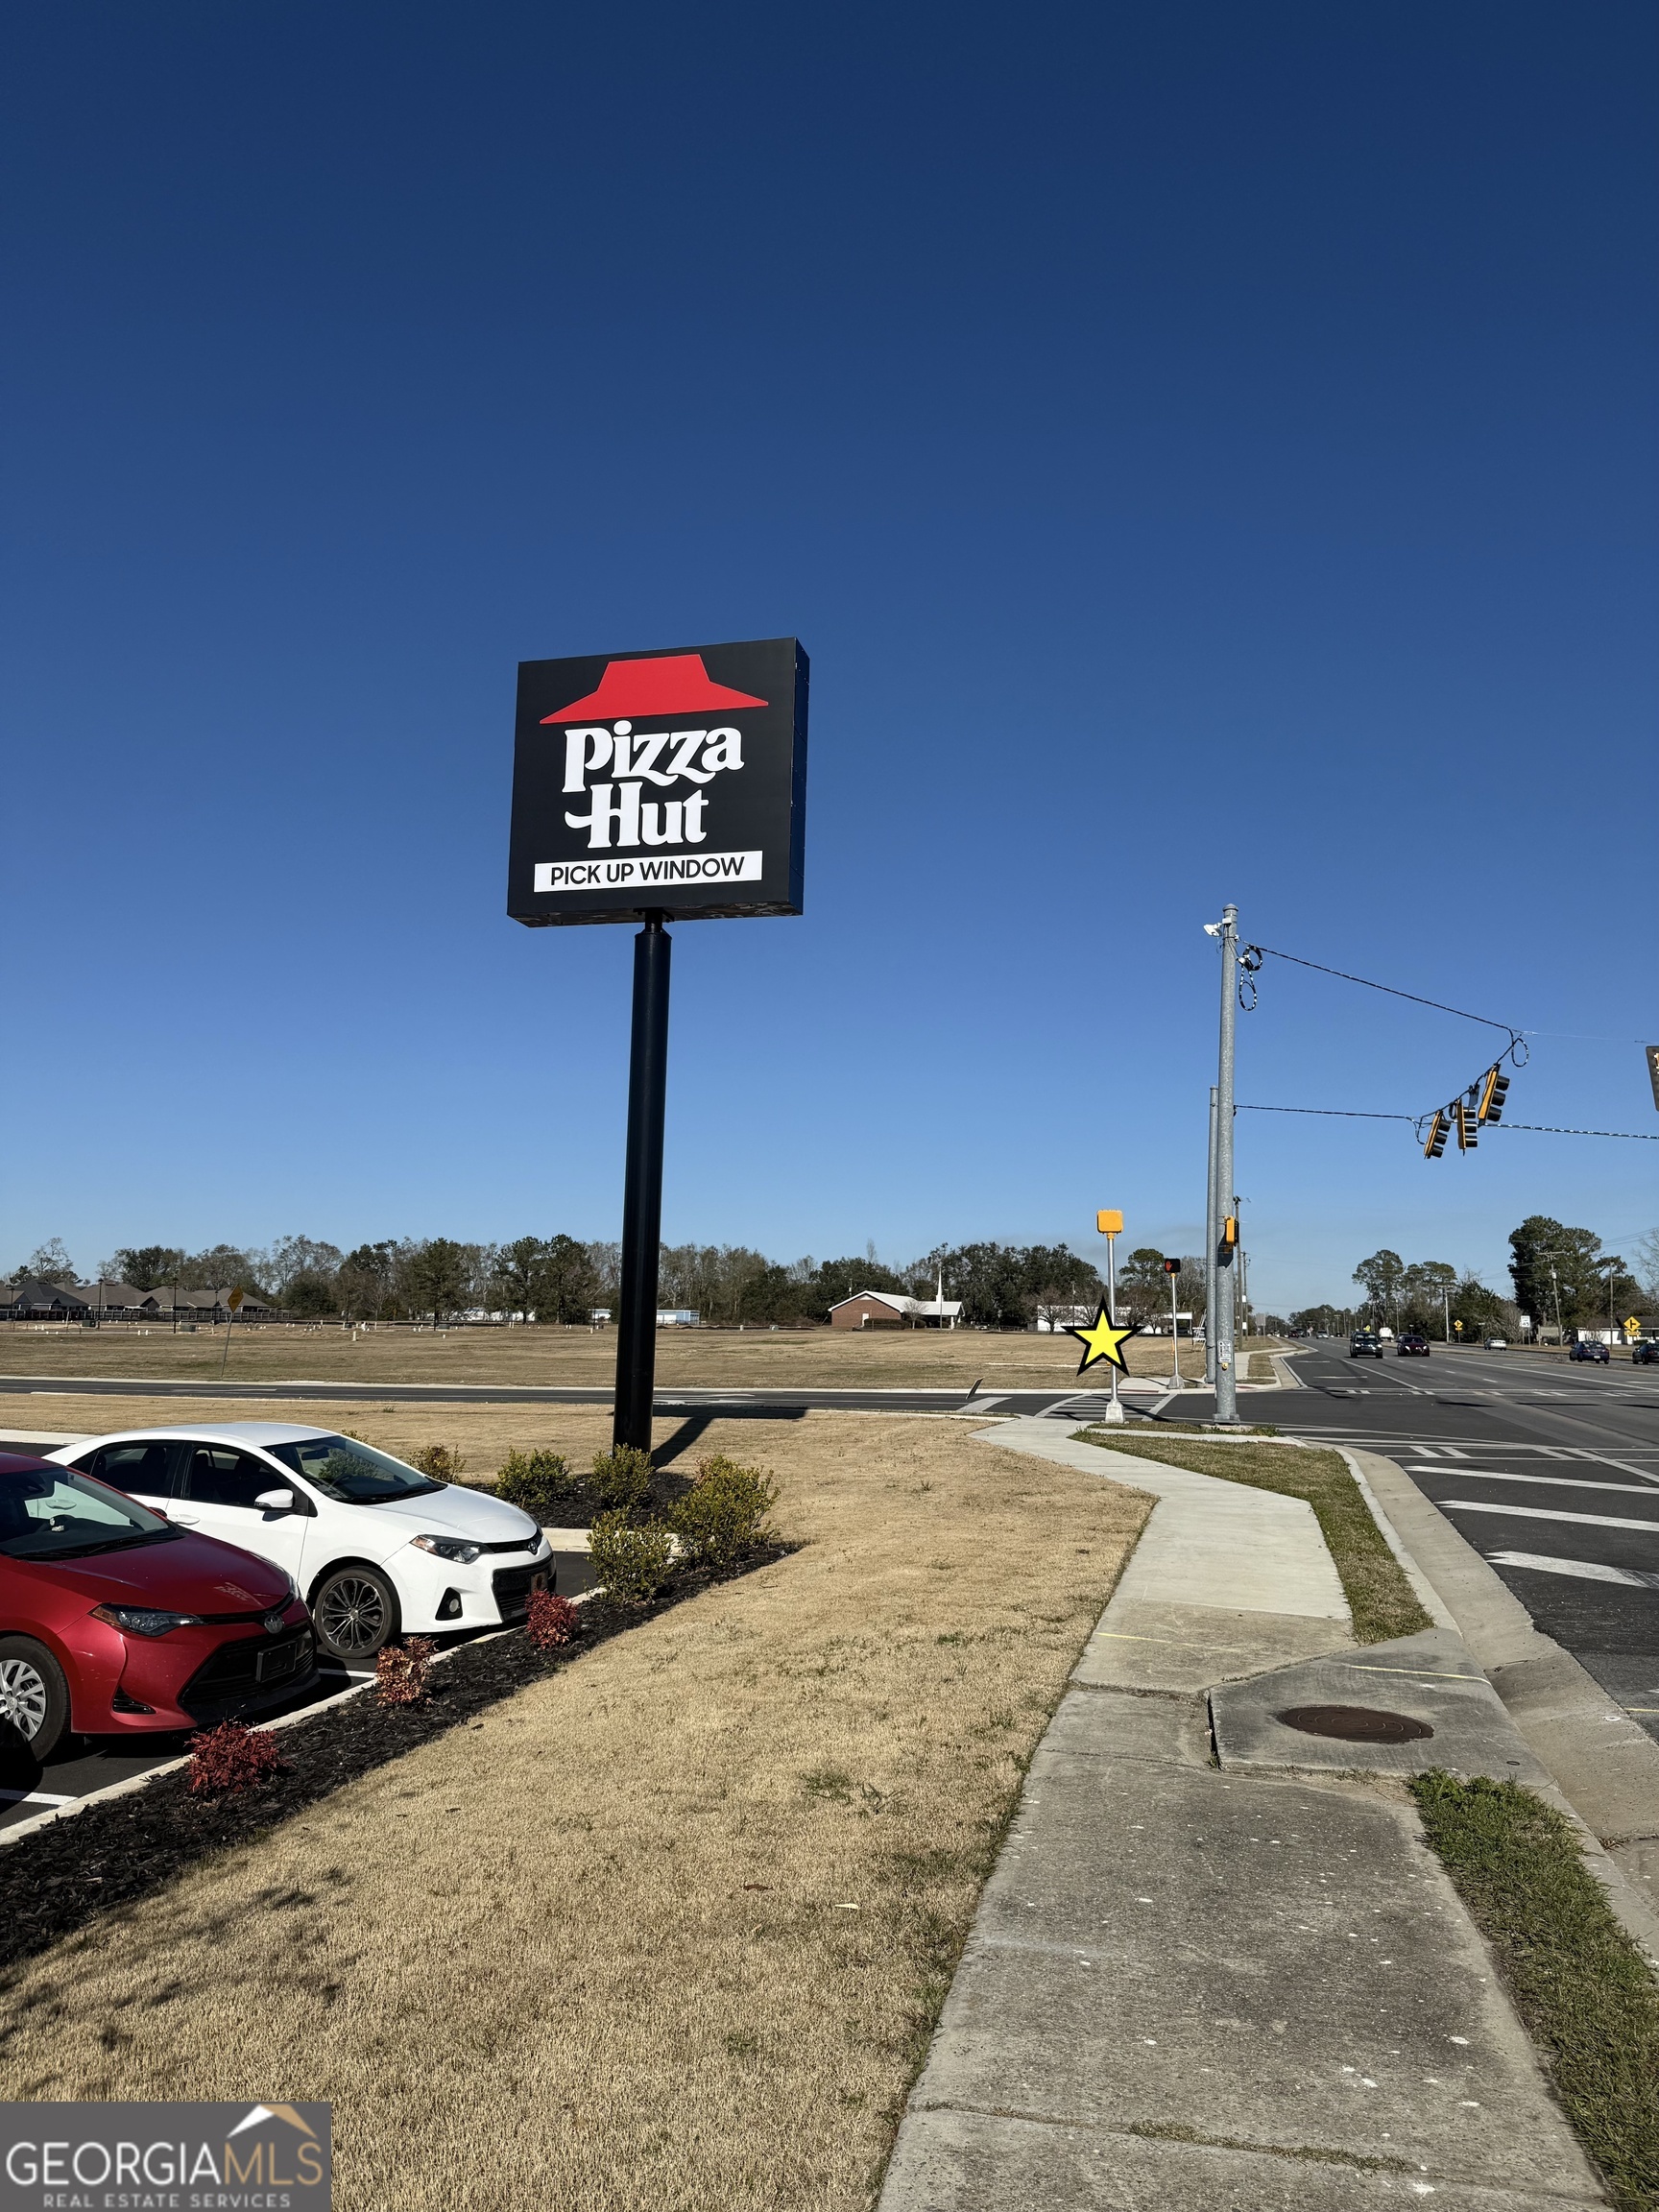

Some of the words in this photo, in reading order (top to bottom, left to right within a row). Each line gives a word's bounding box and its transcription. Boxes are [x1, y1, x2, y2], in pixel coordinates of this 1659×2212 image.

[562, 720, 745, 793] Pizza
[564, 781, 709, 849] Hut
[550, 865, 600, 885] PICK
[606, 862, 635, 882] UP
[638, 856, 746, 880] WINDOW
